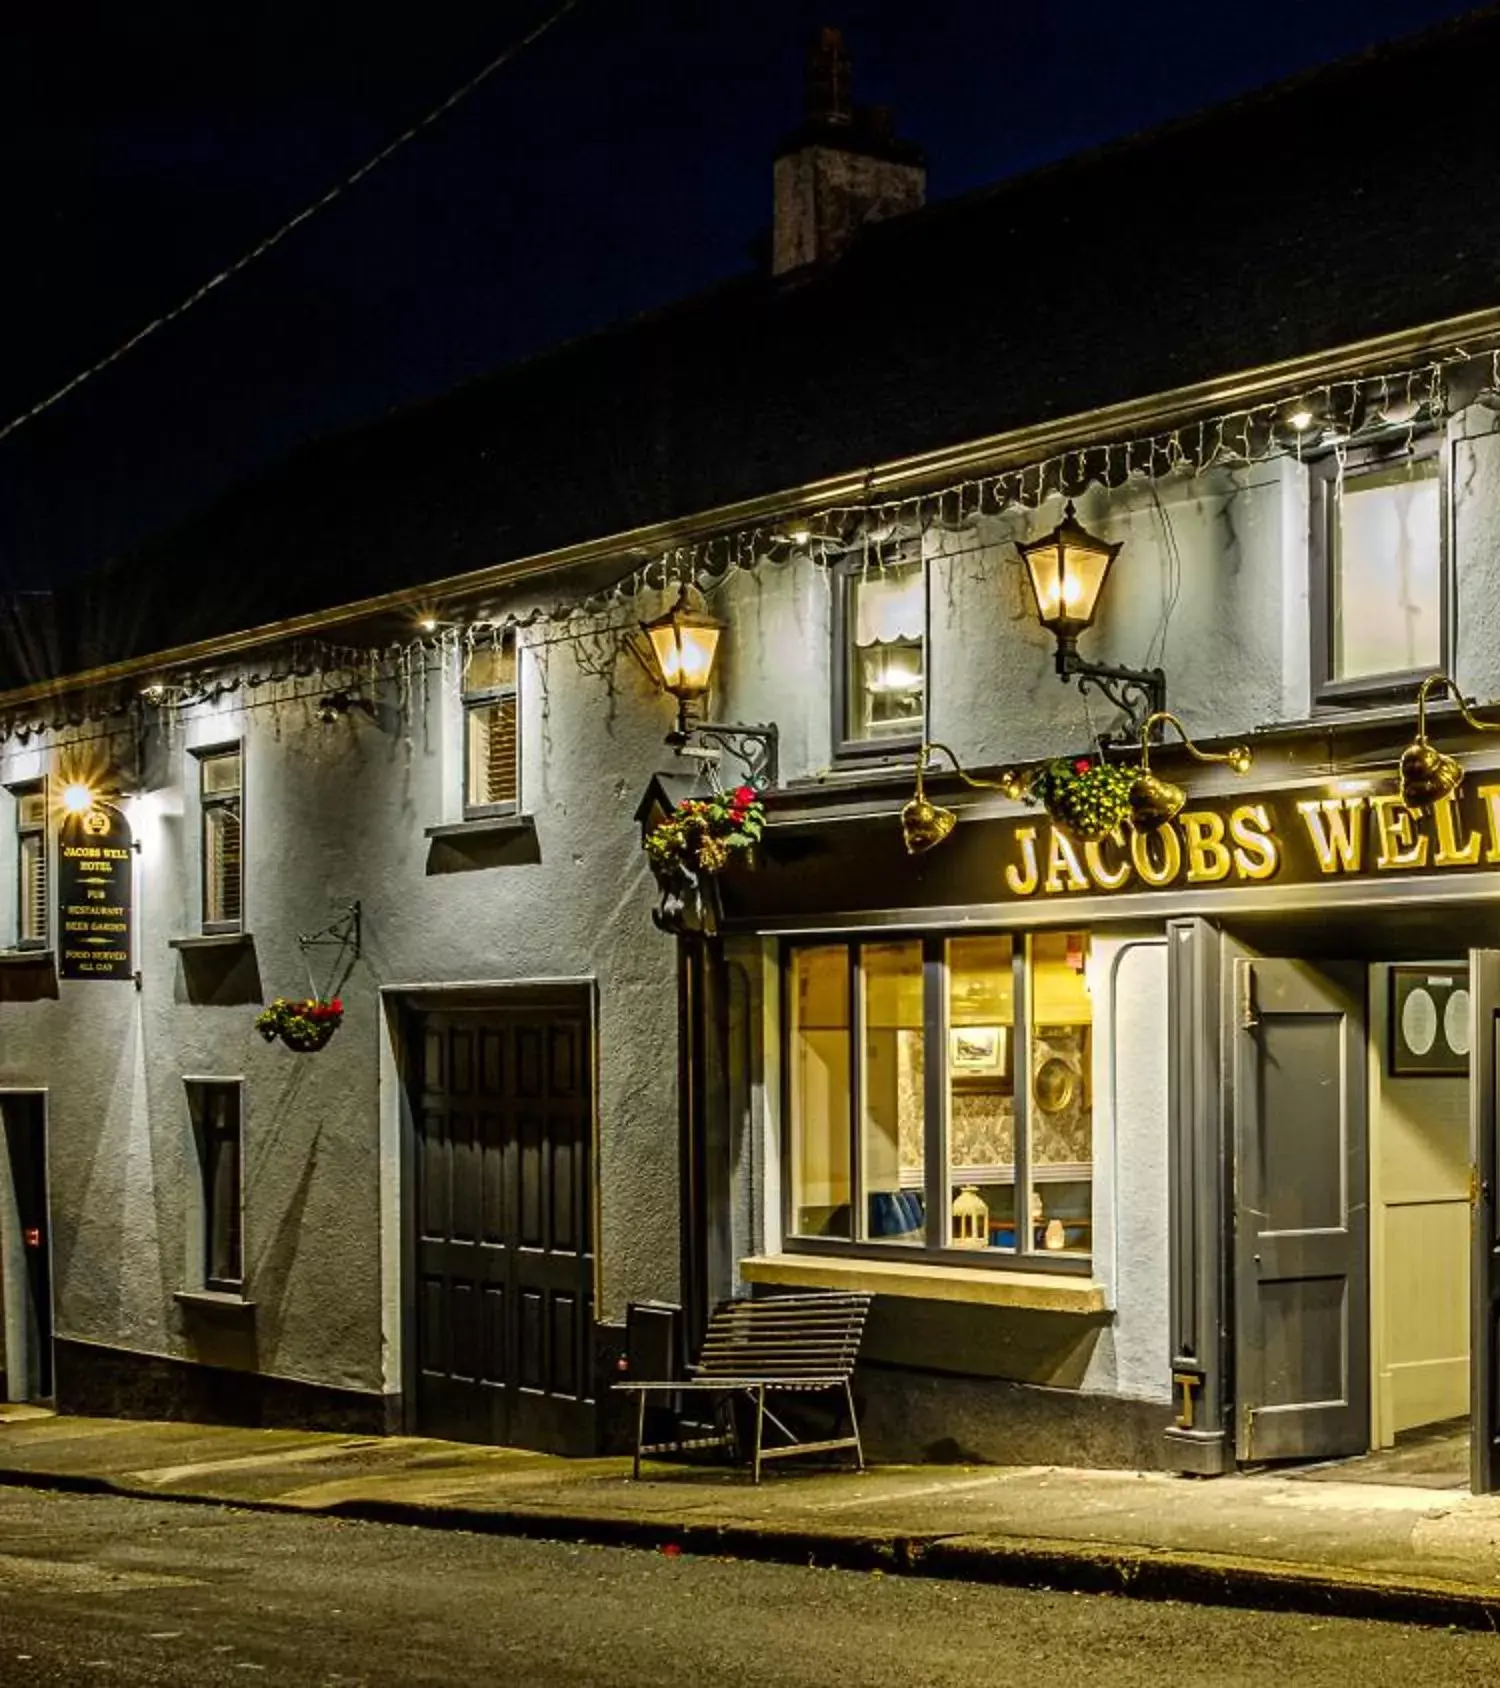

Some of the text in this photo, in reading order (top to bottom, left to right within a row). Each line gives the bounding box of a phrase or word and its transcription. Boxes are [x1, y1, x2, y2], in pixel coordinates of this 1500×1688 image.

[64, 847, 128, 859] JACOBS WELL
[1004, 804, 1280, 895] JACOBS
[80, 861, 112, 872] HOTEL
[87, 889, 106, 899] PUB
[67, 905, 125, 916] RESTAURANT
[91, 922, 127, 932] GARDEN
